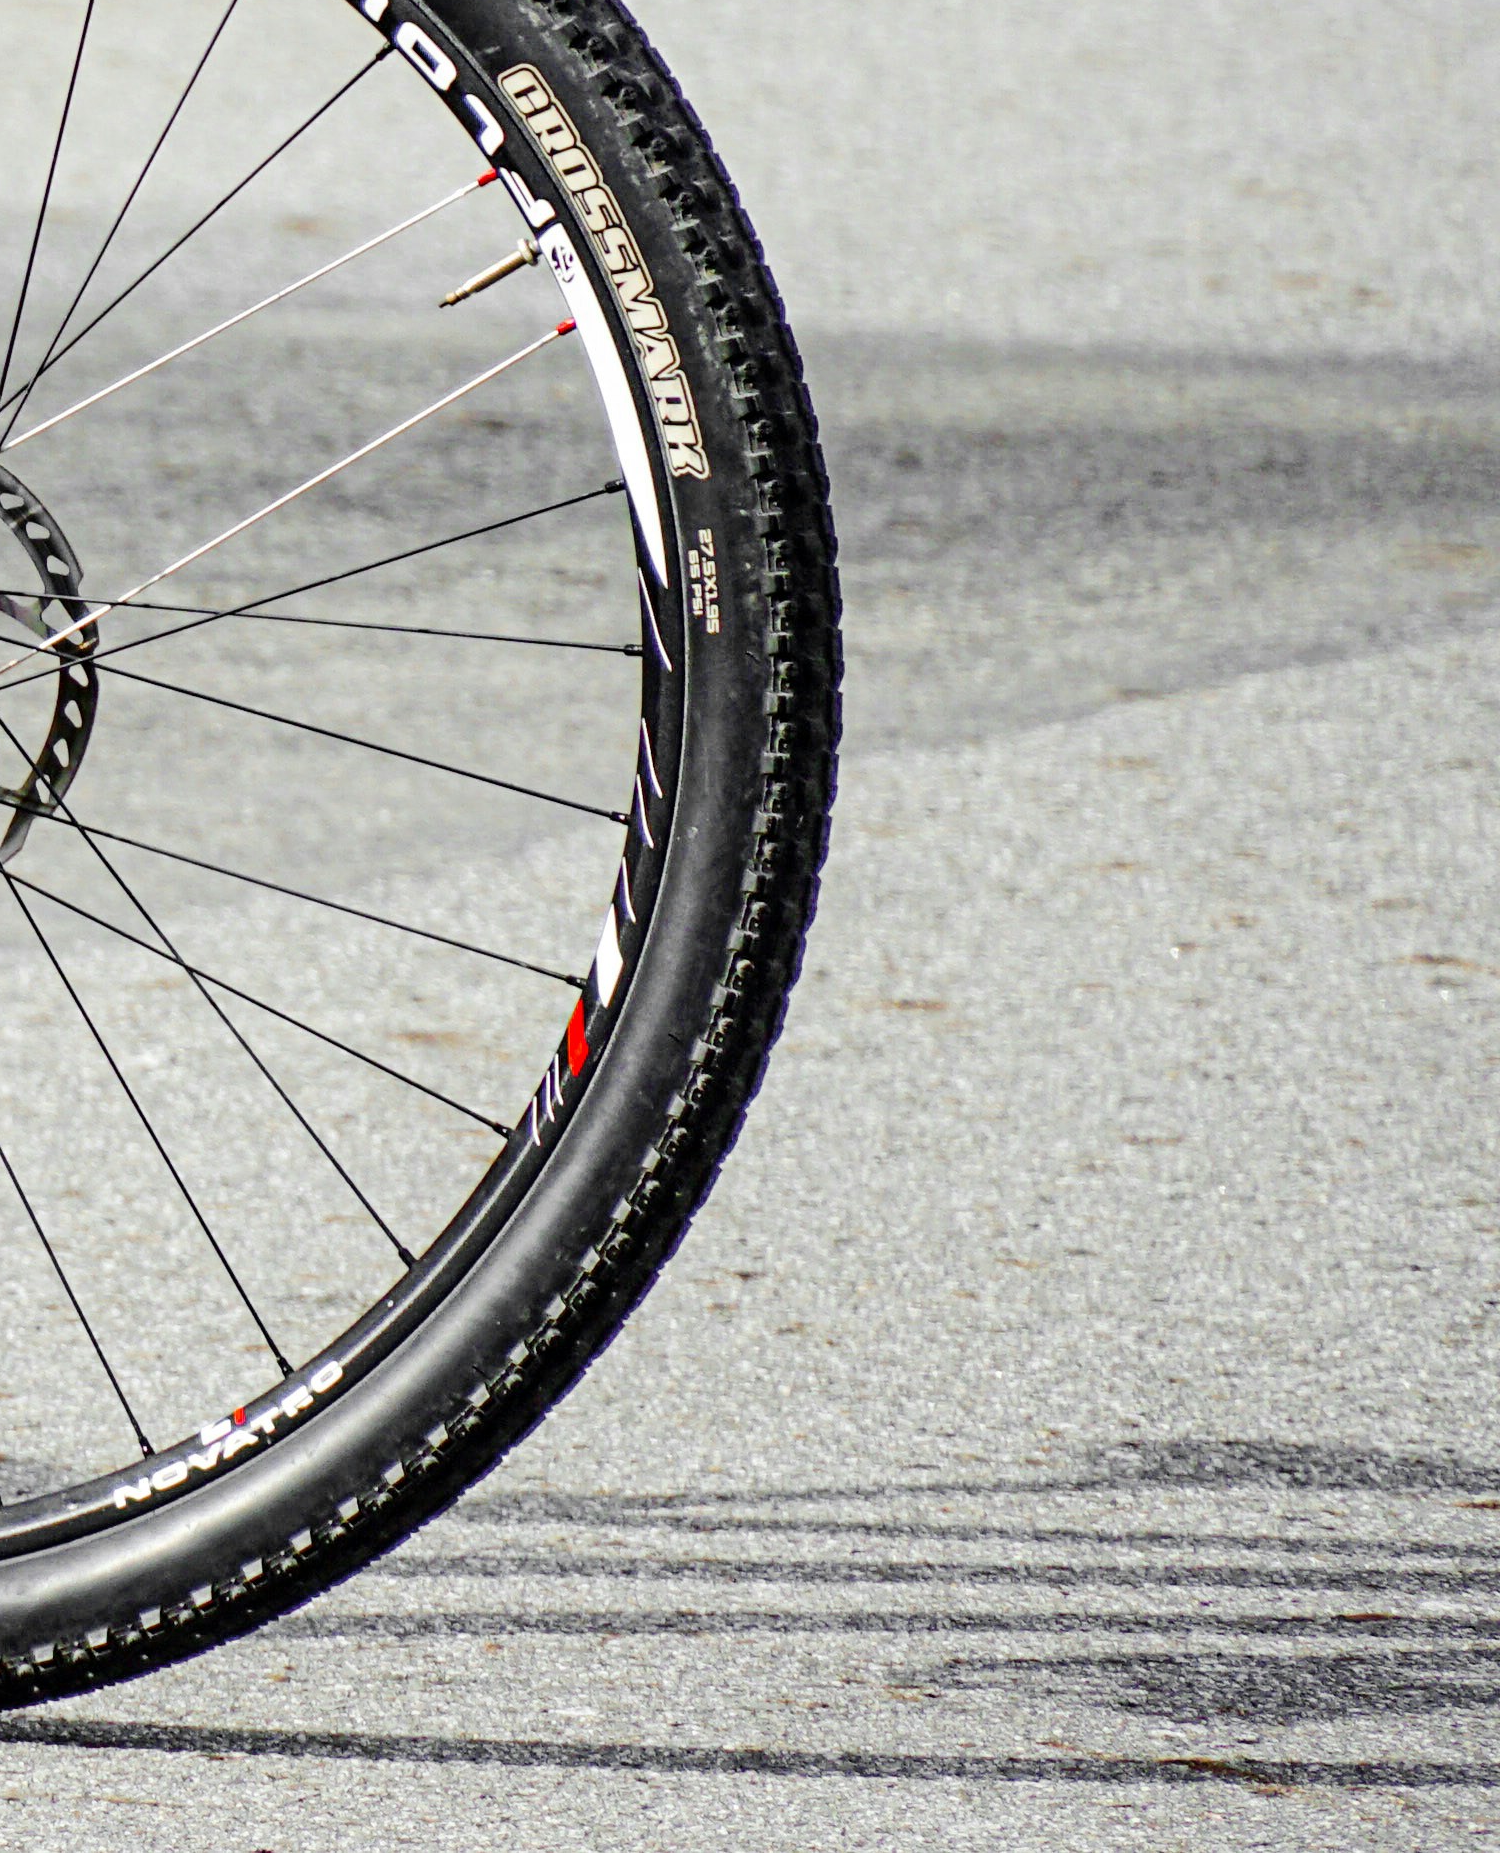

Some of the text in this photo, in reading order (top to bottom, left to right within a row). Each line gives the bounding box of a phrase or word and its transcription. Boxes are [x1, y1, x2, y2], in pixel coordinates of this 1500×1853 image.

[498, 61, 709, 480] CROSSMARK
[688, 549, 704, 616] 65 PSI
[698, 528, 720, 634] 27.5X1.95
[113, 1360, 344, 1509] NOVATEC
